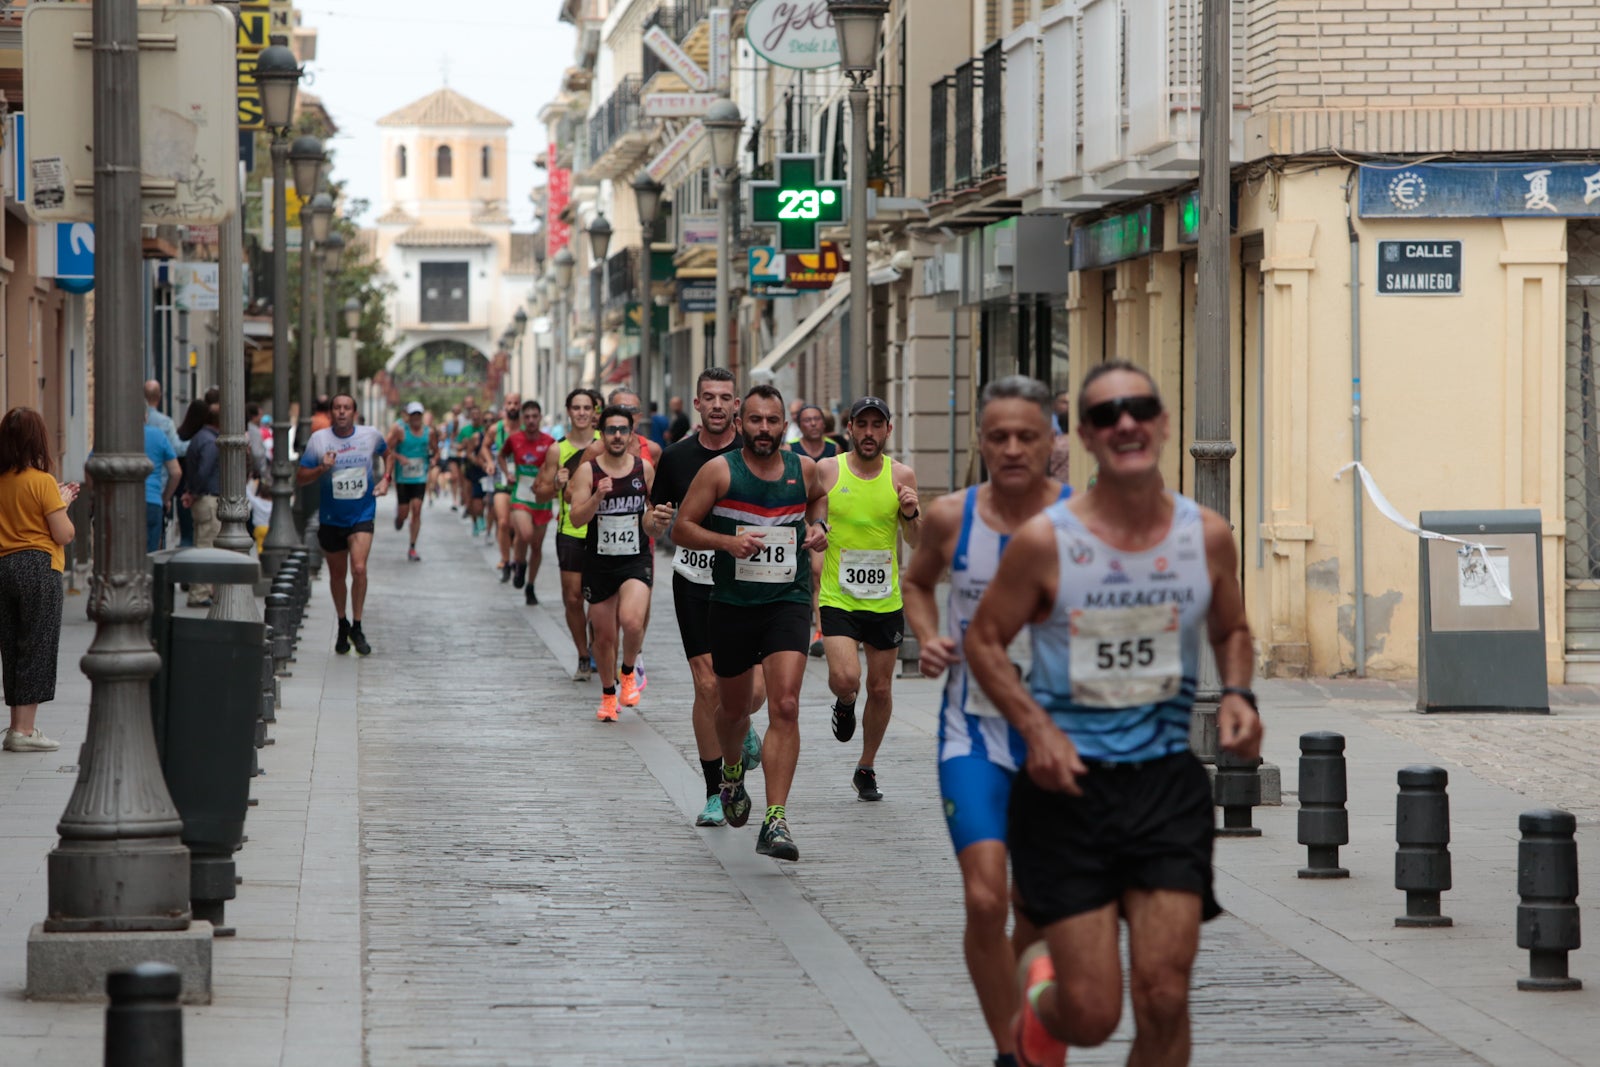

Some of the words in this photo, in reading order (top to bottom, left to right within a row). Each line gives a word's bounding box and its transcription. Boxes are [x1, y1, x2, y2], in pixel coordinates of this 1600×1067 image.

[778, 189, 836, 219] 23°
[1405, 244, 1454, 259] CALLE
[336, 479, 364, 491] 3134
[602, 530, 635, 544] 3142
[749, 546, 785, 564] 218
[845, 568, 887, 585] 3089
[1096, 637, 1155, 671] 555
